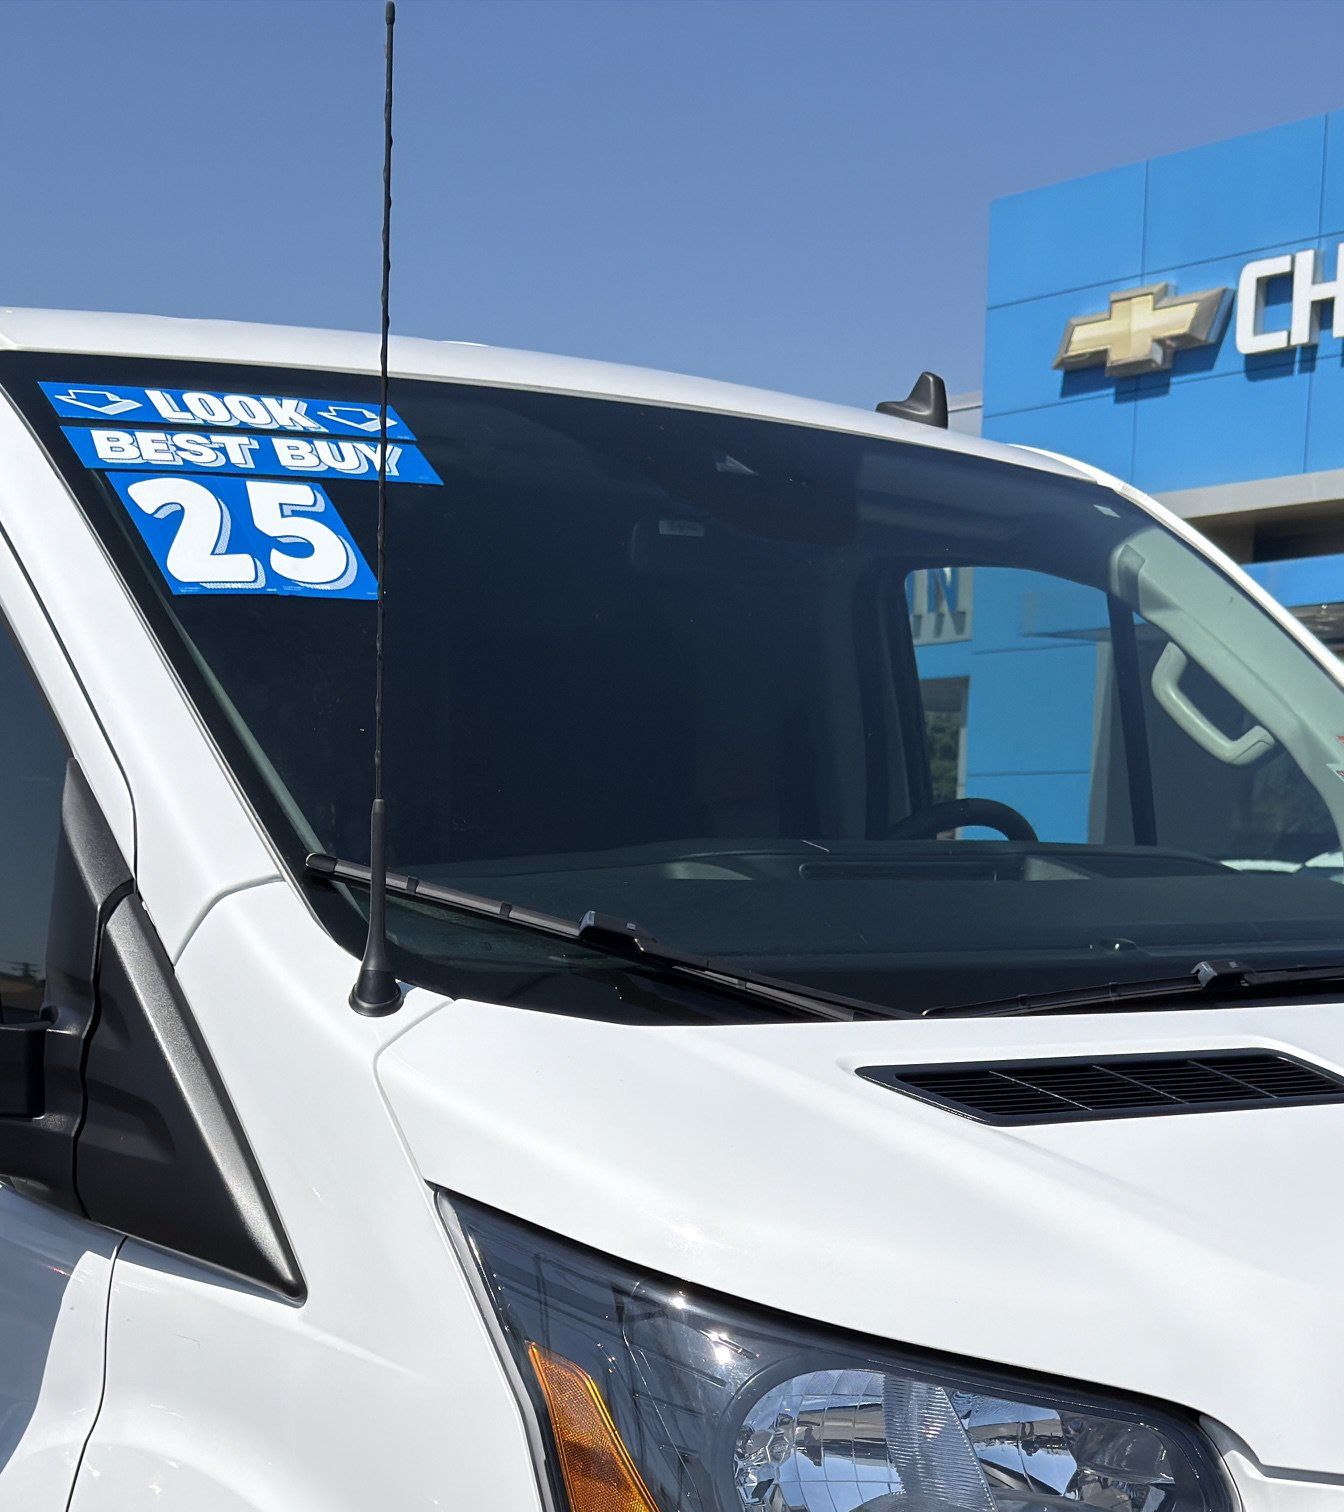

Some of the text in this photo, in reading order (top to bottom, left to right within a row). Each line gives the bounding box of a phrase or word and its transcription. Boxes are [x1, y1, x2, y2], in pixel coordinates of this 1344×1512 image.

[144, 388, 328, 432] LOOK
[90, 428, 403, 476] BEST BUY
[126, 477, 358, 590] 25
